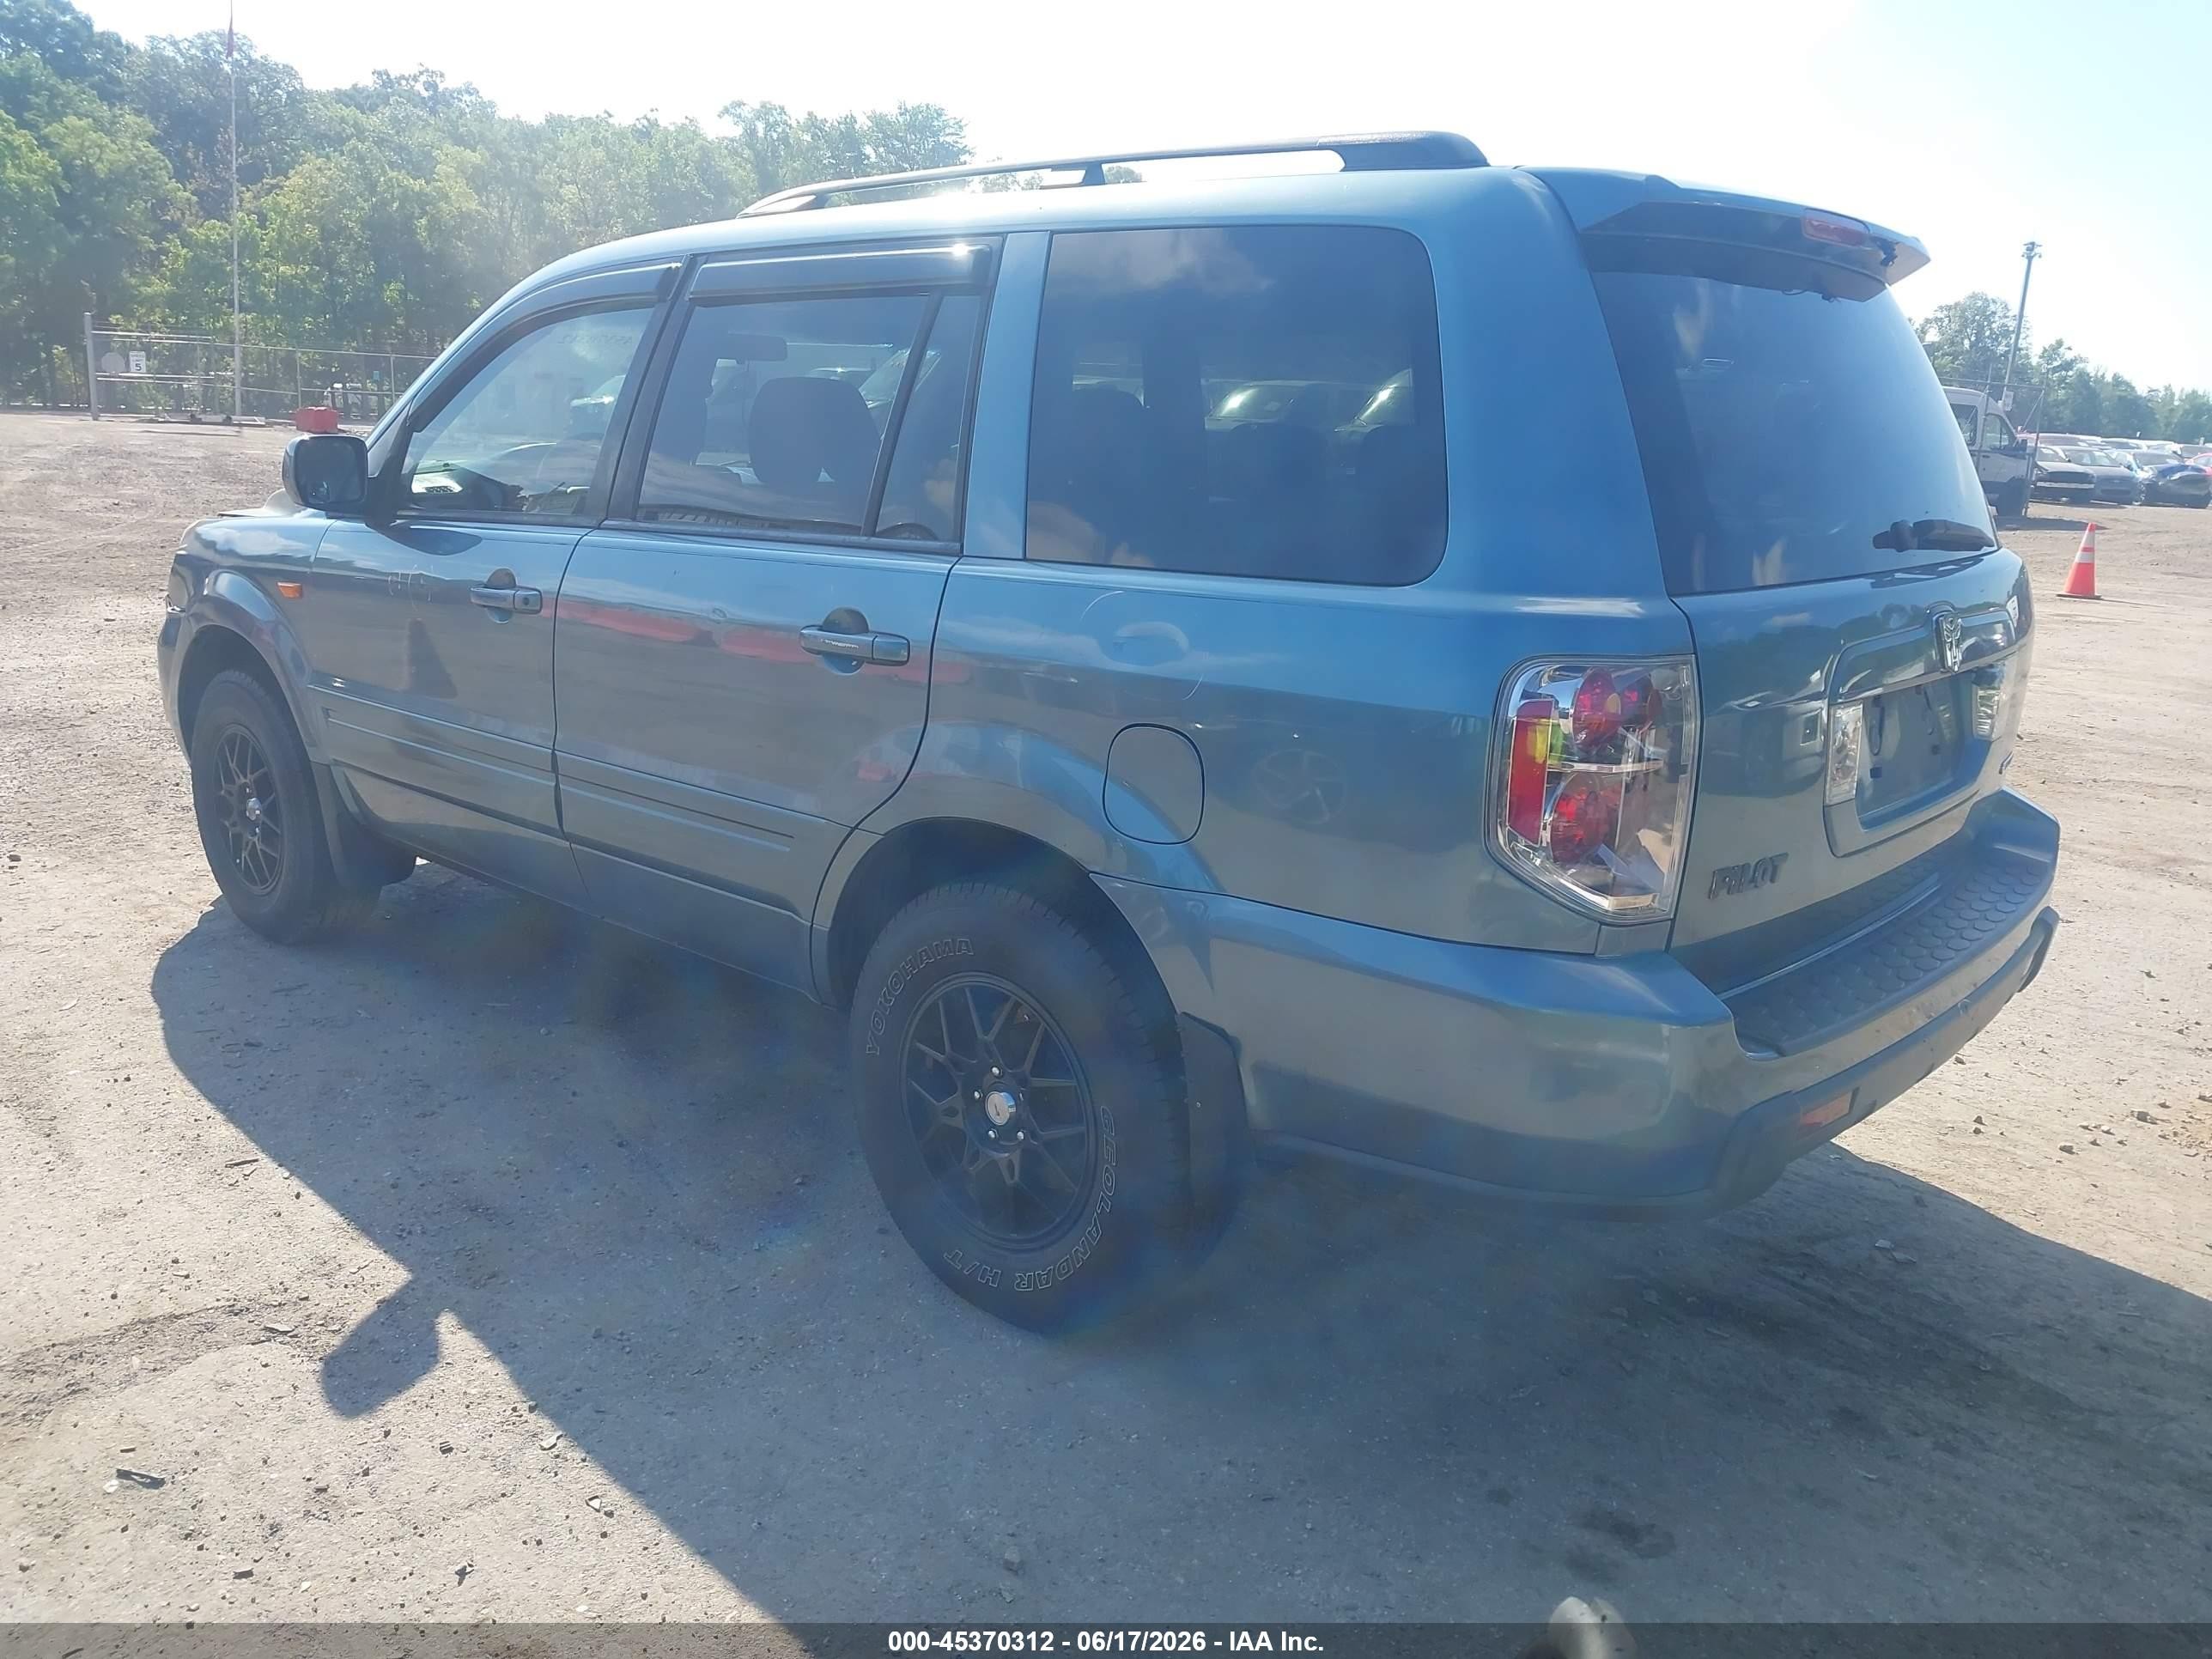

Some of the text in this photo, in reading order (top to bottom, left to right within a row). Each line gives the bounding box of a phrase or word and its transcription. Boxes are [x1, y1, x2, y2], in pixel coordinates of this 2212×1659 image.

[135, 362, 142, 371] 5
[1707, 852, 1789, 900] PILOT
[866, 938, 974, 1055] YOKOHAMA
[944, 1106, 1116, 1291] GEOLANDAR H/T
